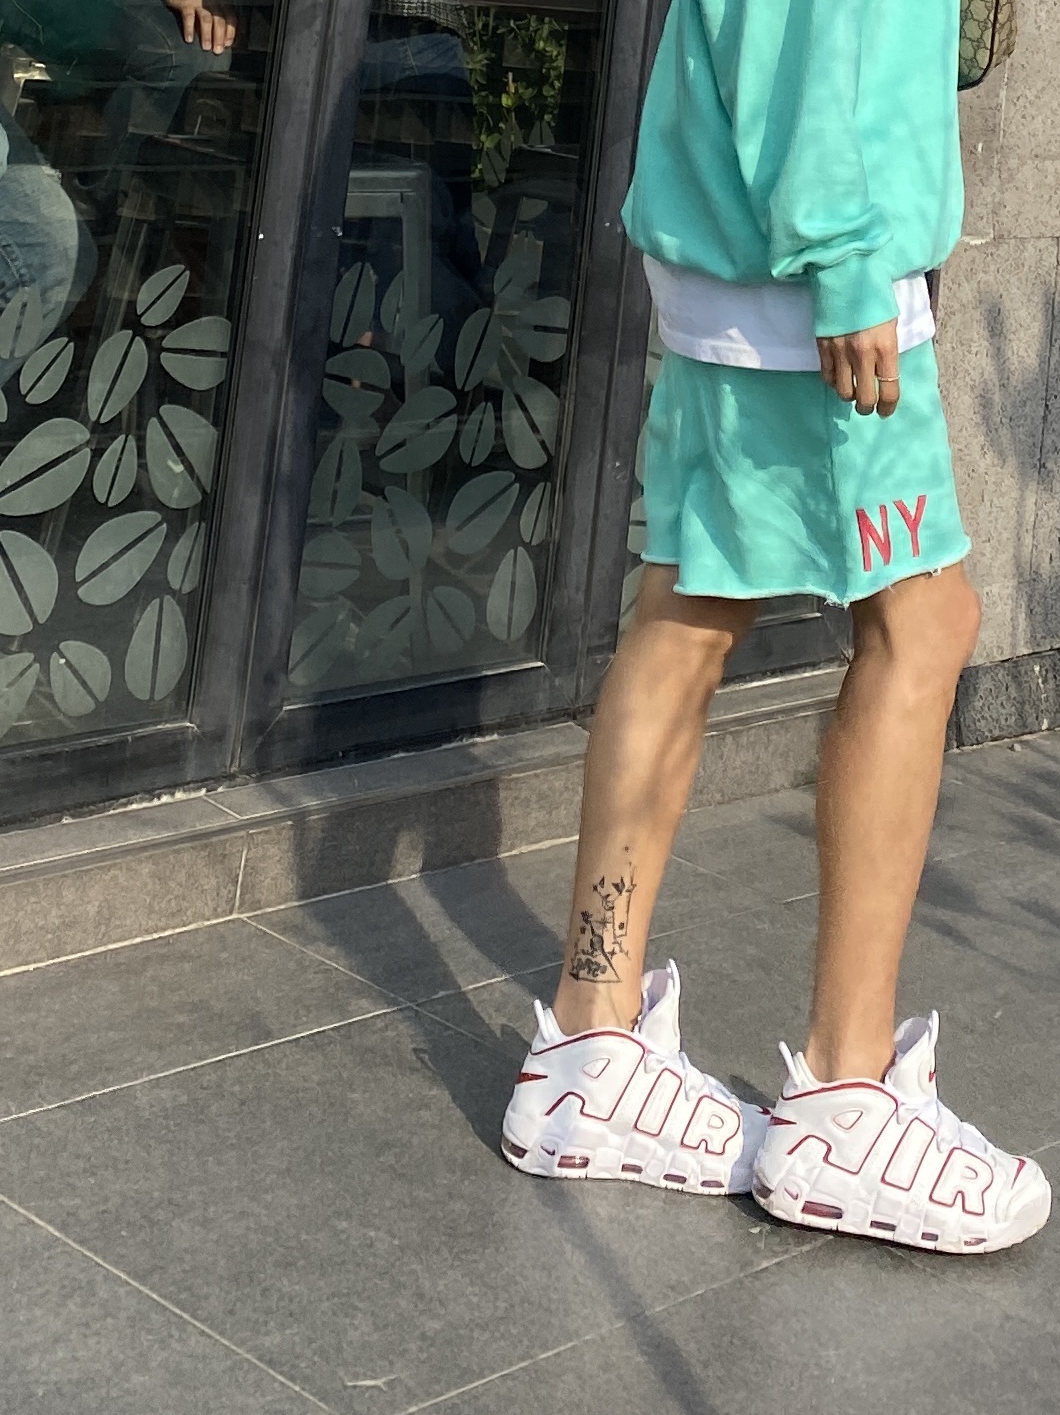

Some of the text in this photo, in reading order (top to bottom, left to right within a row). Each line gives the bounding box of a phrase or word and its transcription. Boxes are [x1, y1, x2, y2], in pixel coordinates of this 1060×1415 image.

[855, 494, 927, 572] NY
[545, 1031, 741, 1155] AIR
[787, 1082, 995, 1216] AIR
